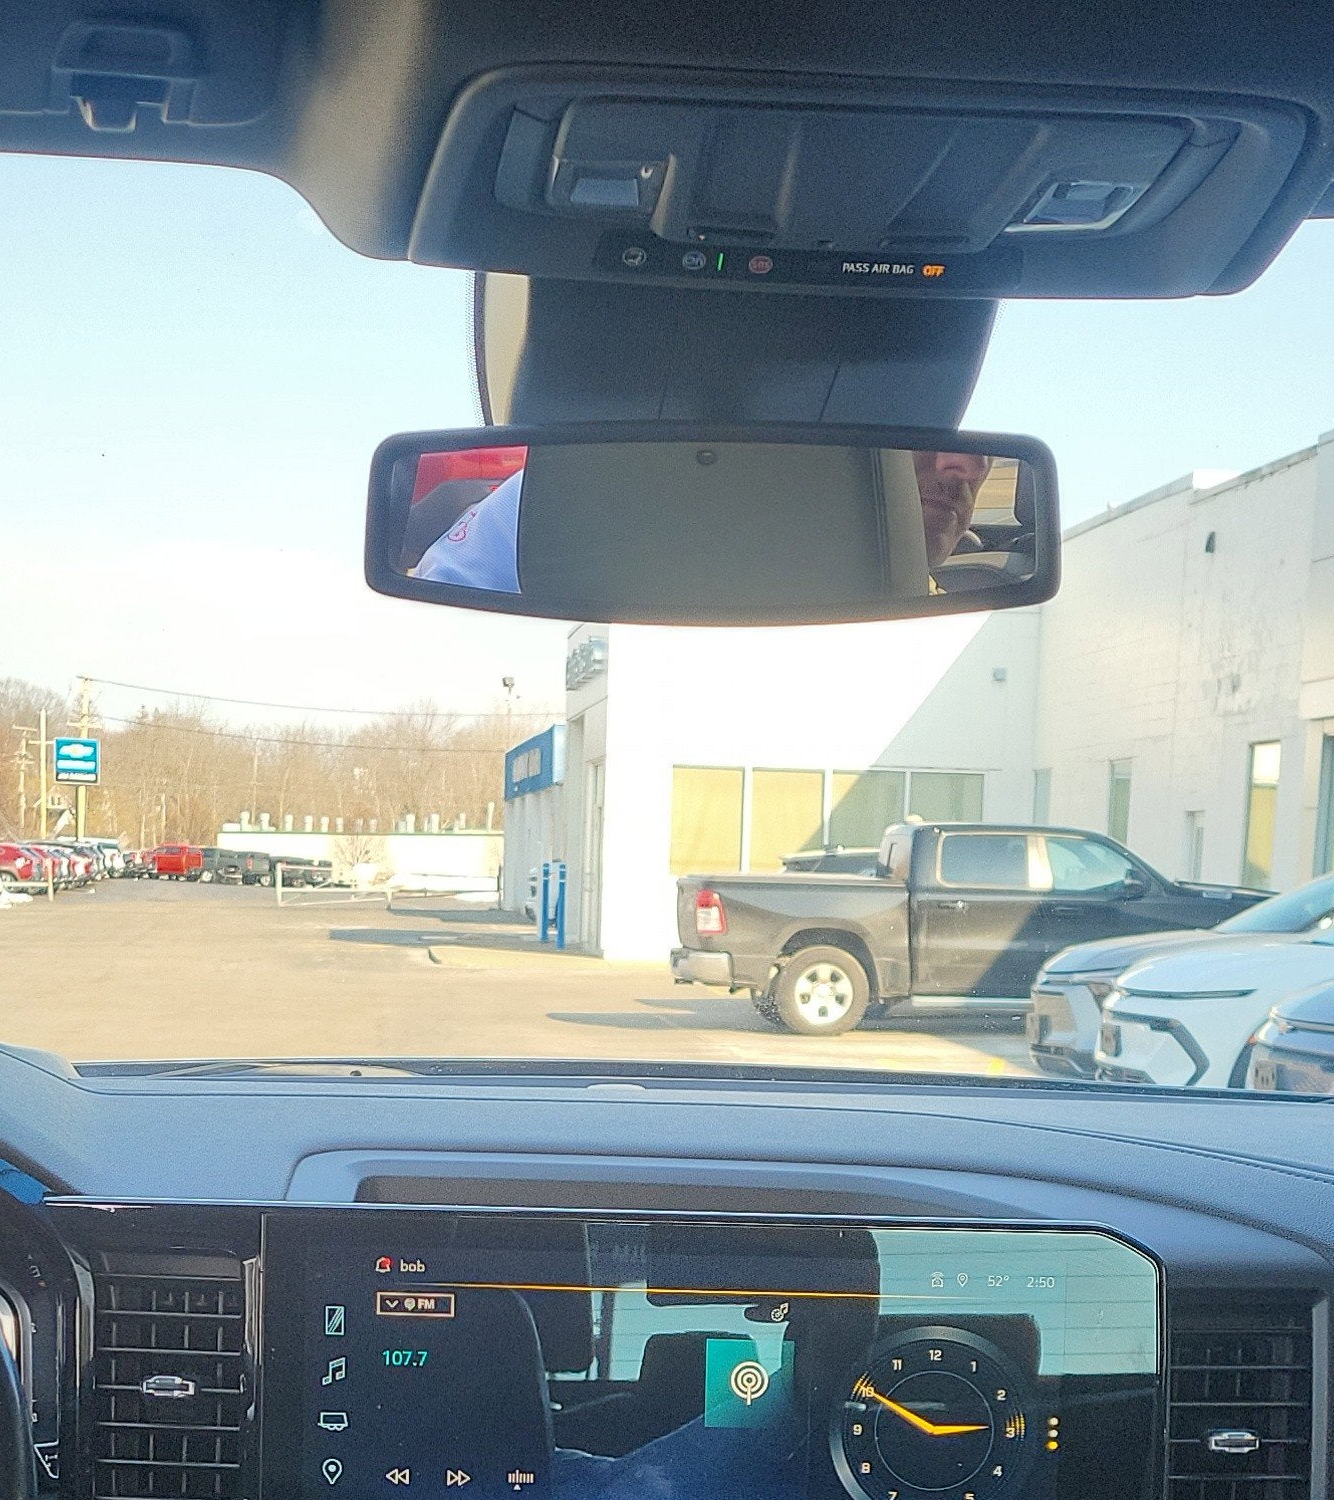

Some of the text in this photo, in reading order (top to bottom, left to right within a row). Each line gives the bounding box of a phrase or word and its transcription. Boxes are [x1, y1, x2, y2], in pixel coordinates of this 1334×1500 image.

[842, 262, 916, 276] PASS AIR BAG
[921, 263, 945, 278] OFF
[399, 1258, 426, 1273] bob
[987, 1275, 1056, 1289] 52° 2:50
[417, 1298, 436, 1311] FM
[381, 1349, 428, 1367] 107.7
[928, 1349, 943, 1361] 12
[891, 1359, 904, 1371] 11
[970, 1360, 978, 1373] 1
[996, 1389, 1007, 1401] 2
[852, 1424, 863, 1436] 9
[1005, 1427, 1016, 1439] 3
[860, 1462, 871, 1474] 8
[992, 1465, 1004, 1477] 4
